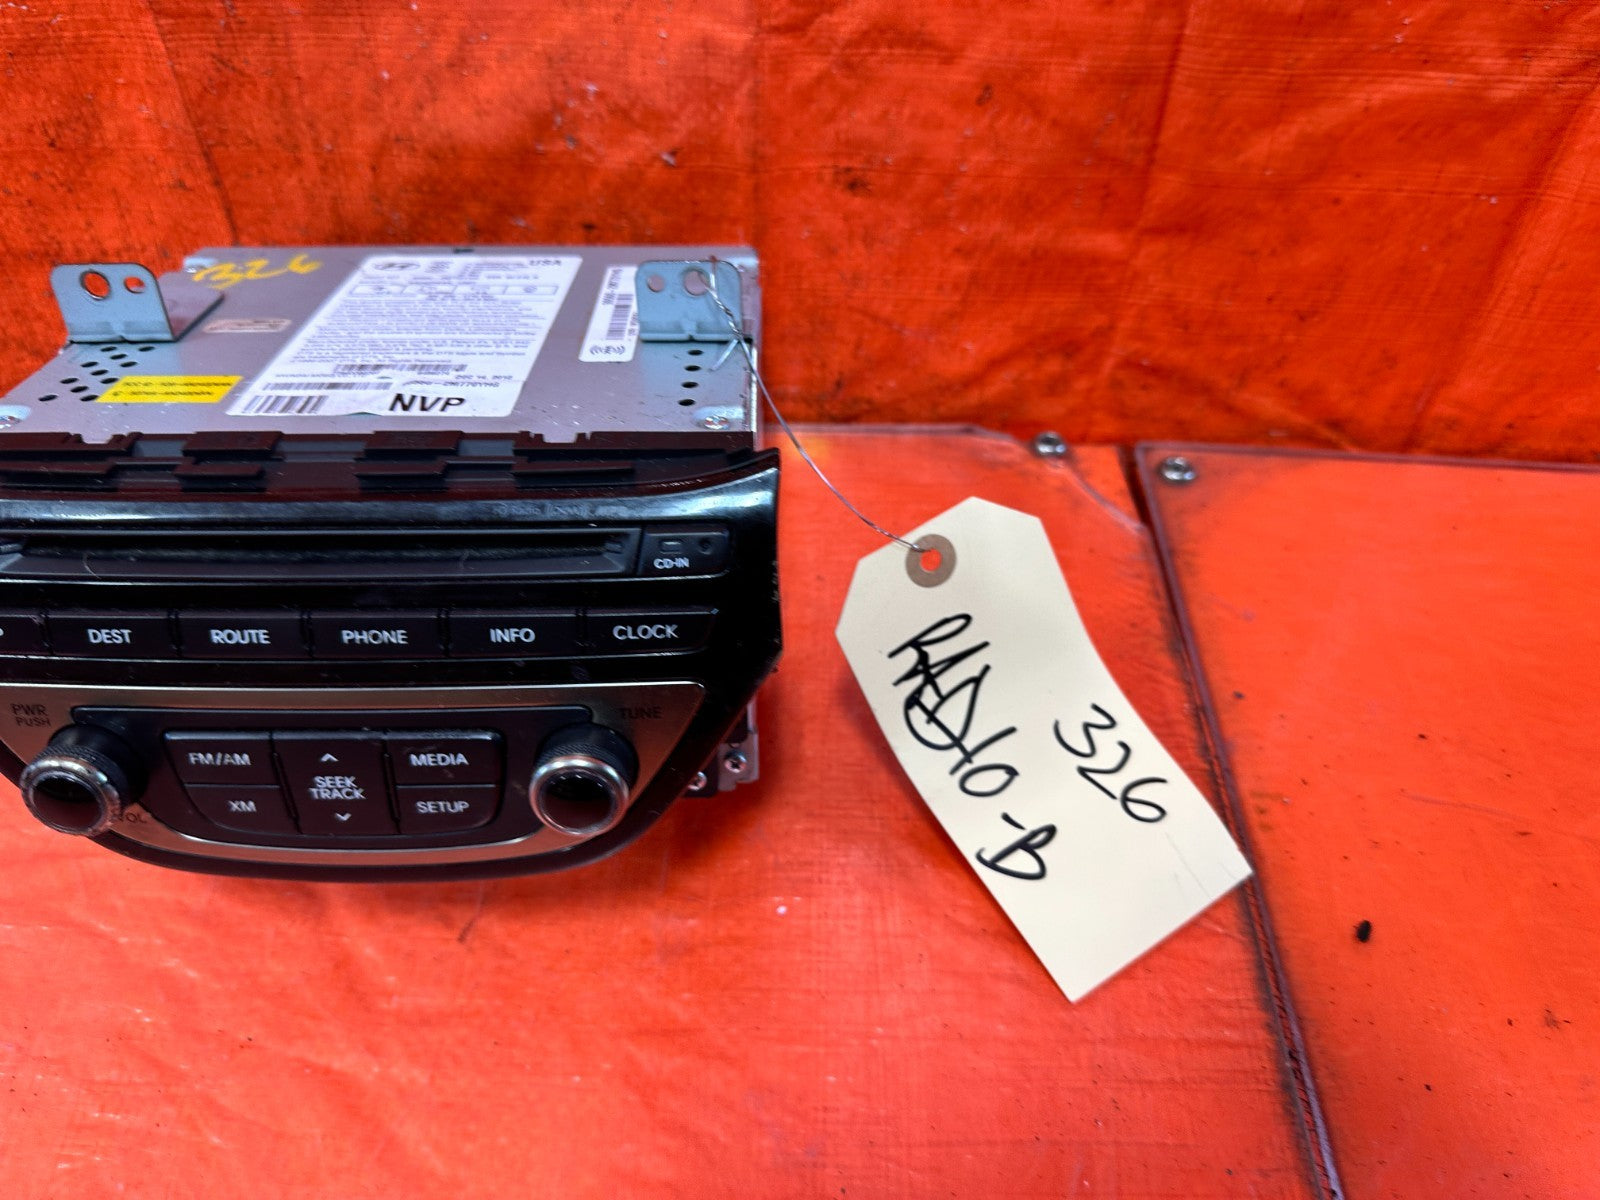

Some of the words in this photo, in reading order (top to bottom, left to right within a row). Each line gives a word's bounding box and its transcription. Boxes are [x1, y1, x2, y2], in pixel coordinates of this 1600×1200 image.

[192, 254, 323, 291] 326
[389, 392, 467, 413] NVP
[87, 628, 132, 644] DEST
[209, 628, 271, 646] ROUTE
[341, 629, 409, 647] PHONE
[489, 628, 536, 643] INFO
[612, 624, 680, 641] CLOCK
[10, 703, 48, 716] PWR
[617, 706, 664, 720] TUNE
[15, 716, 51, 727] PUSH
[188, 752, 252, 766] FM/AM
[408, 753, 469, 767] MEDIA
[1053, 702, 1168, 823] 326
[312, 775, 358, 789] SEEK
[308, 787, 367, 800] TRACK
[227, 799, 257, 812] XM
[415, 800, 470, 814] SETUP
